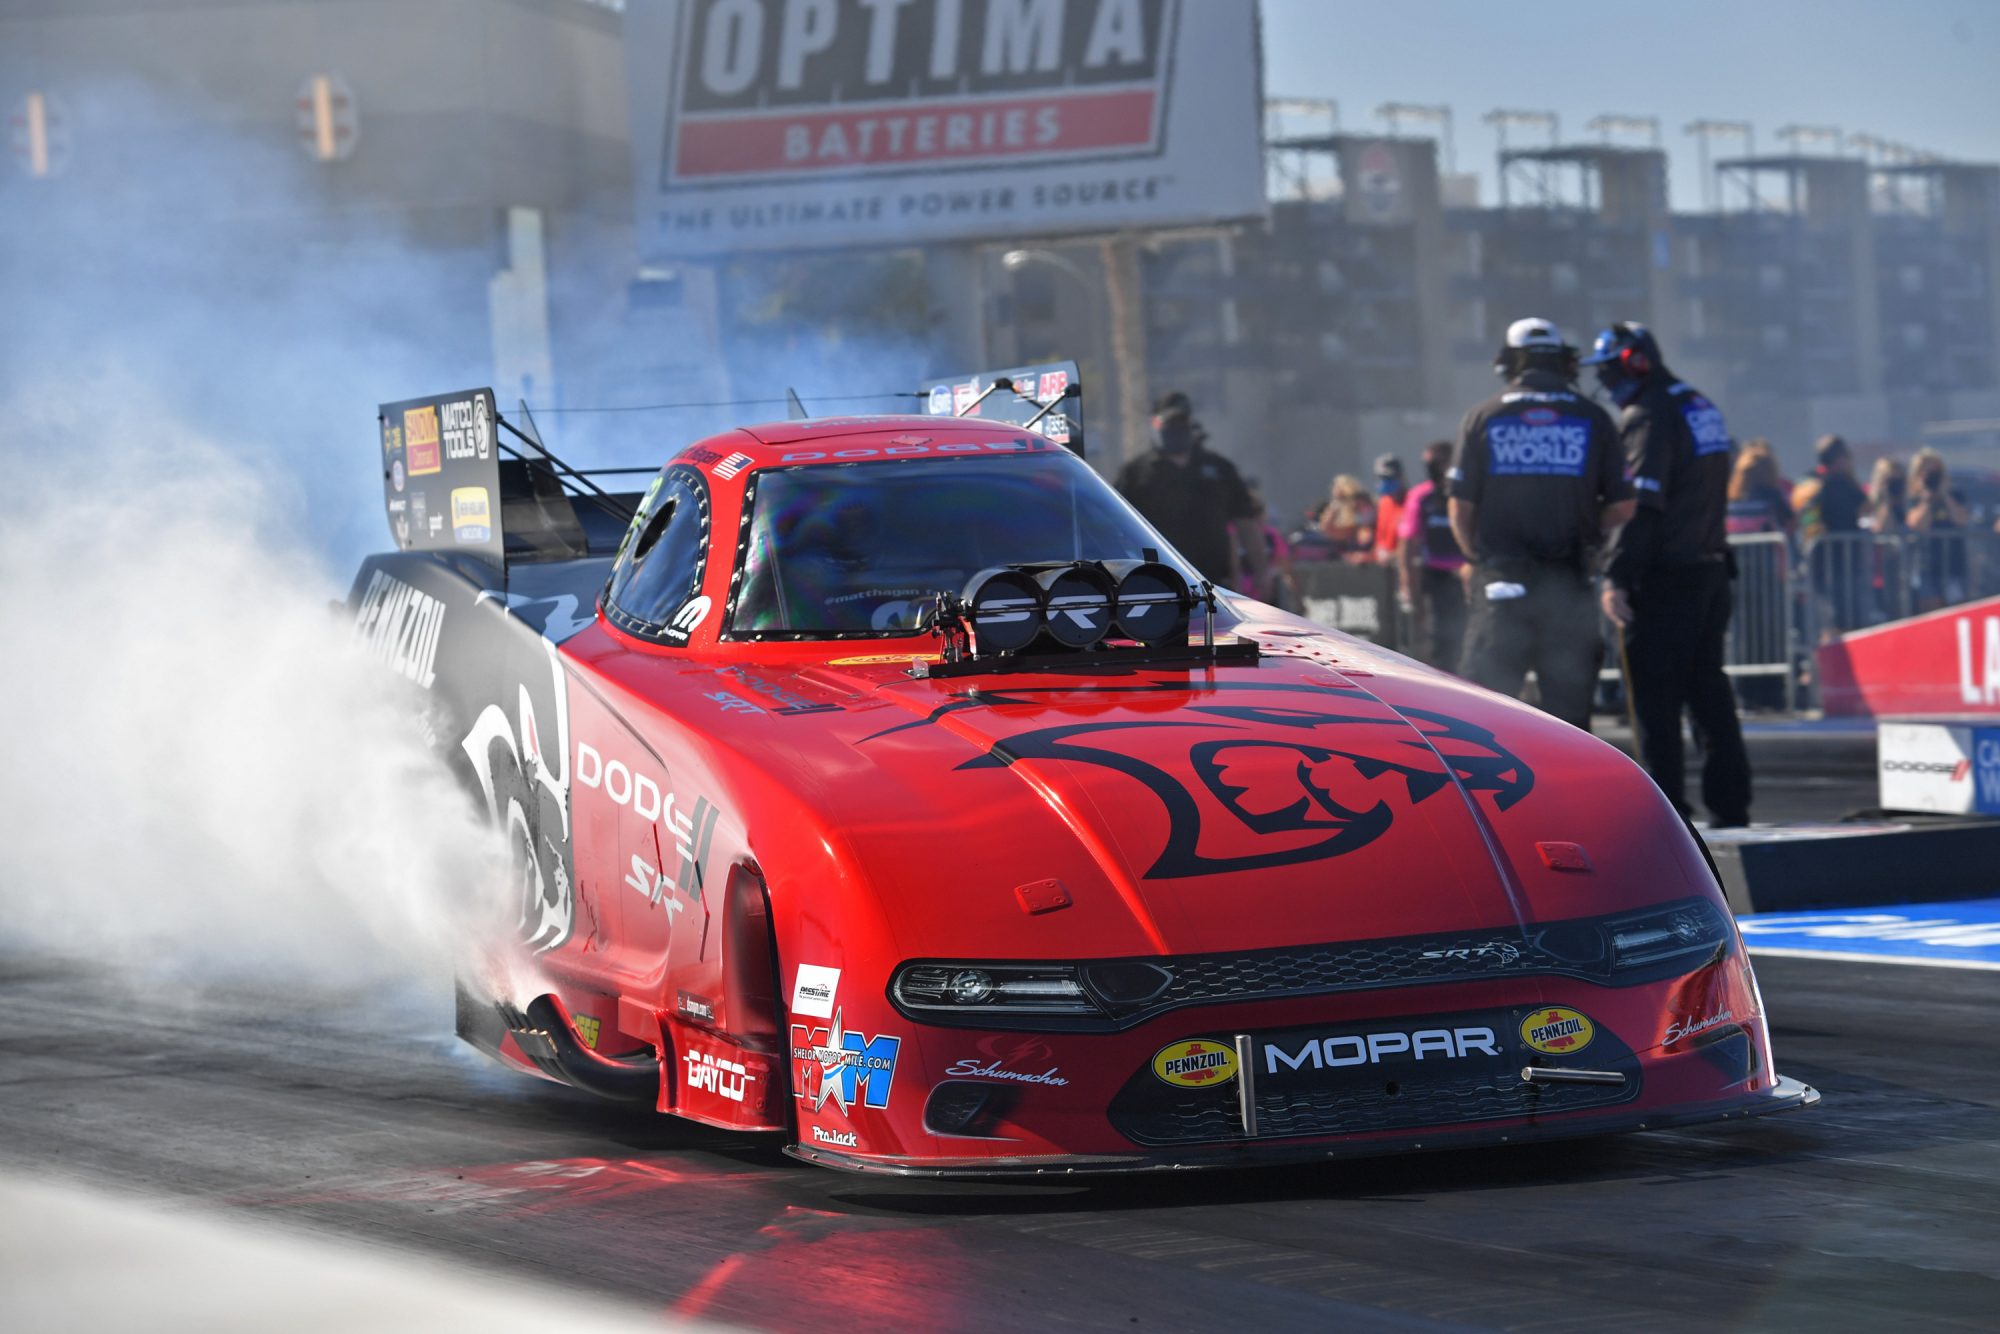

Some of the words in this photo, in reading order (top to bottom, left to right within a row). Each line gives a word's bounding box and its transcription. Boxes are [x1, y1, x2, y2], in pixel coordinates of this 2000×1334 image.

[701, 0, 1146, 95] OPTIMA
[785, 106, 1062, 161] BATTERIES
[656, 207, 713, 231] THE
[730, 196, 883, 229] ULTIMATE
[899, 188, 1016, 216] POWER
[441, 401, 473, 431] MATCO
[443, 429, 476, 460] TOOLS
[1490, 424, 1586, 445] CAMPING
[781, 443, 1027, 462] DODGE
[1493, 443, 1584, 465] WORLD
[976, 592, 1178, 629] SRT
[703, 691, 768, 714] SRT
[714, 666, 819, 710] DODGE
[1884, 760, 1962, 774] DODGE
[577, 741, 693, 863] DODGE
[1418, 948, 1495, 960] SRT
[1531, 1018, 1587, 1044] PENNZOIL
[1661, 1003, 1733, 1047] Schumacher
[793, 1047, 817, 1061] SHELOR
[844, 1054, 892, 1070] MILE.COM
[1165, 1051, 1231, 1075] PENNZOIL
[1264, 1027, 1501, 1074] MOPAR
[684, 1049, 756, 1102] DAYCO
[945, 1059, 1070, 1087] Schumacher
